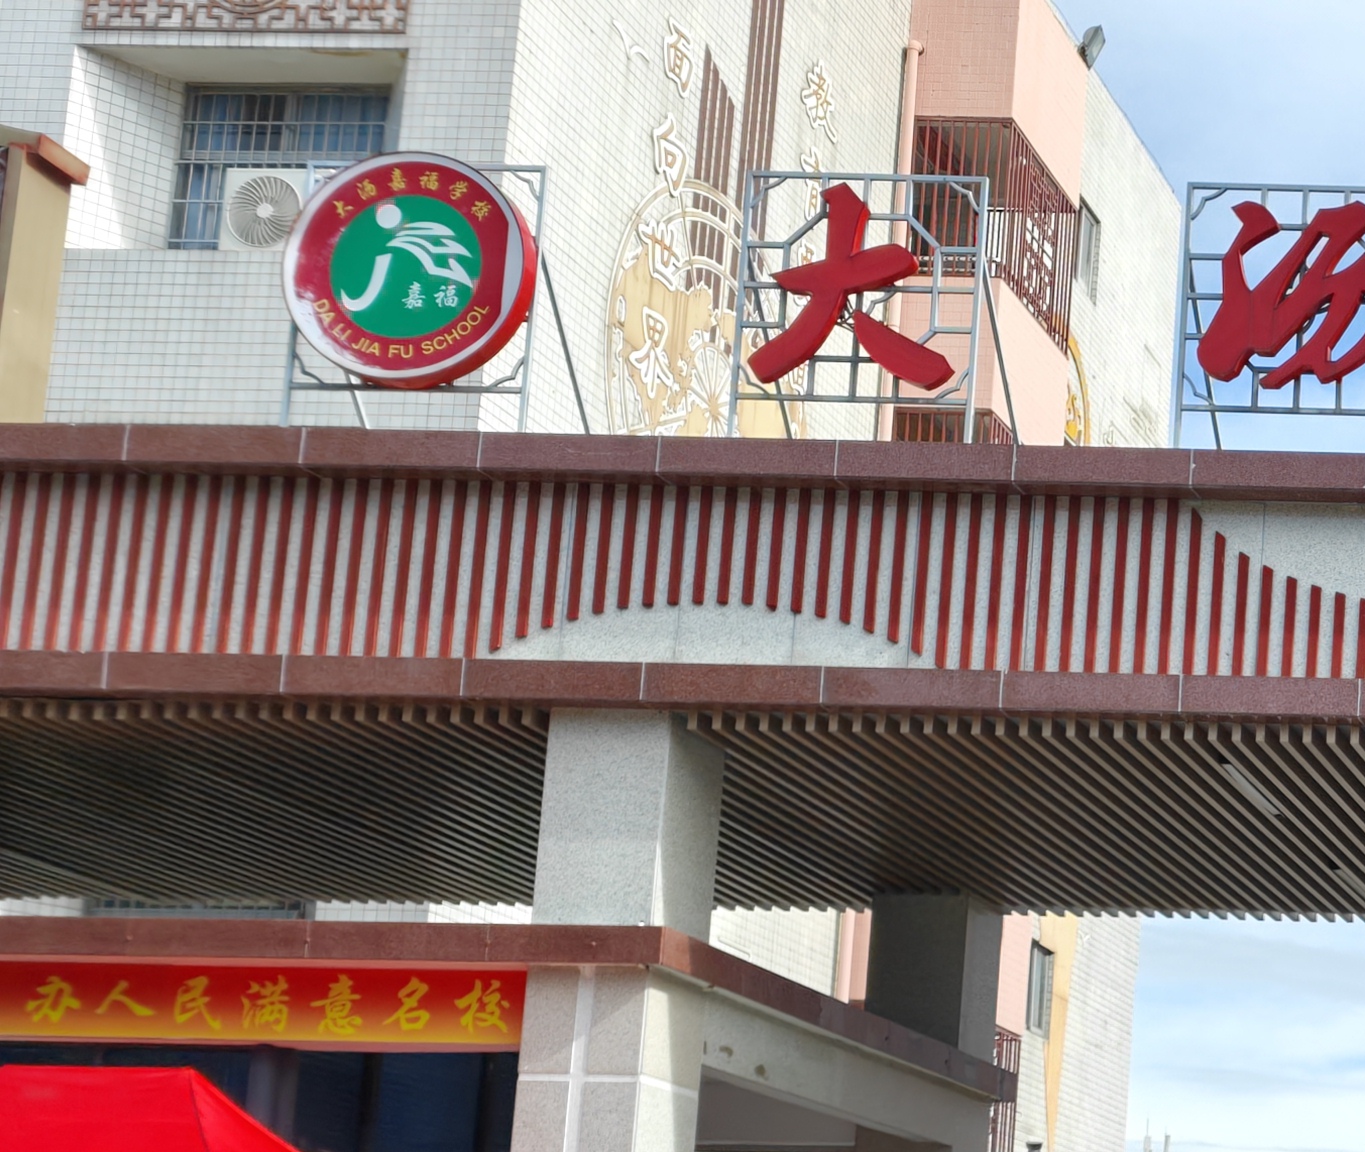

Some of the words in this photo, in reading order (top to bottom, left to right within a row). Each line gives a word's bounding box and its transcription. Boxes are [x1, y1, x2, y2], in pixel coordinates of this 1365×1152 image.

[332, 167, 492, 221] 大沥嘉福学校
[629, 15, 694, 399] 面向世界
[401, 280, 460, 309] 嘉福
[313, 298, 336, 324] DA
[333, 321, 354, 343] LI
[351, 336, 381, 357] JIA
[387, 344, 413, 359] FU
[421, 302, 491, 356] SCHOOL
[25, 973, 514, 1036] 办人民满意名校
